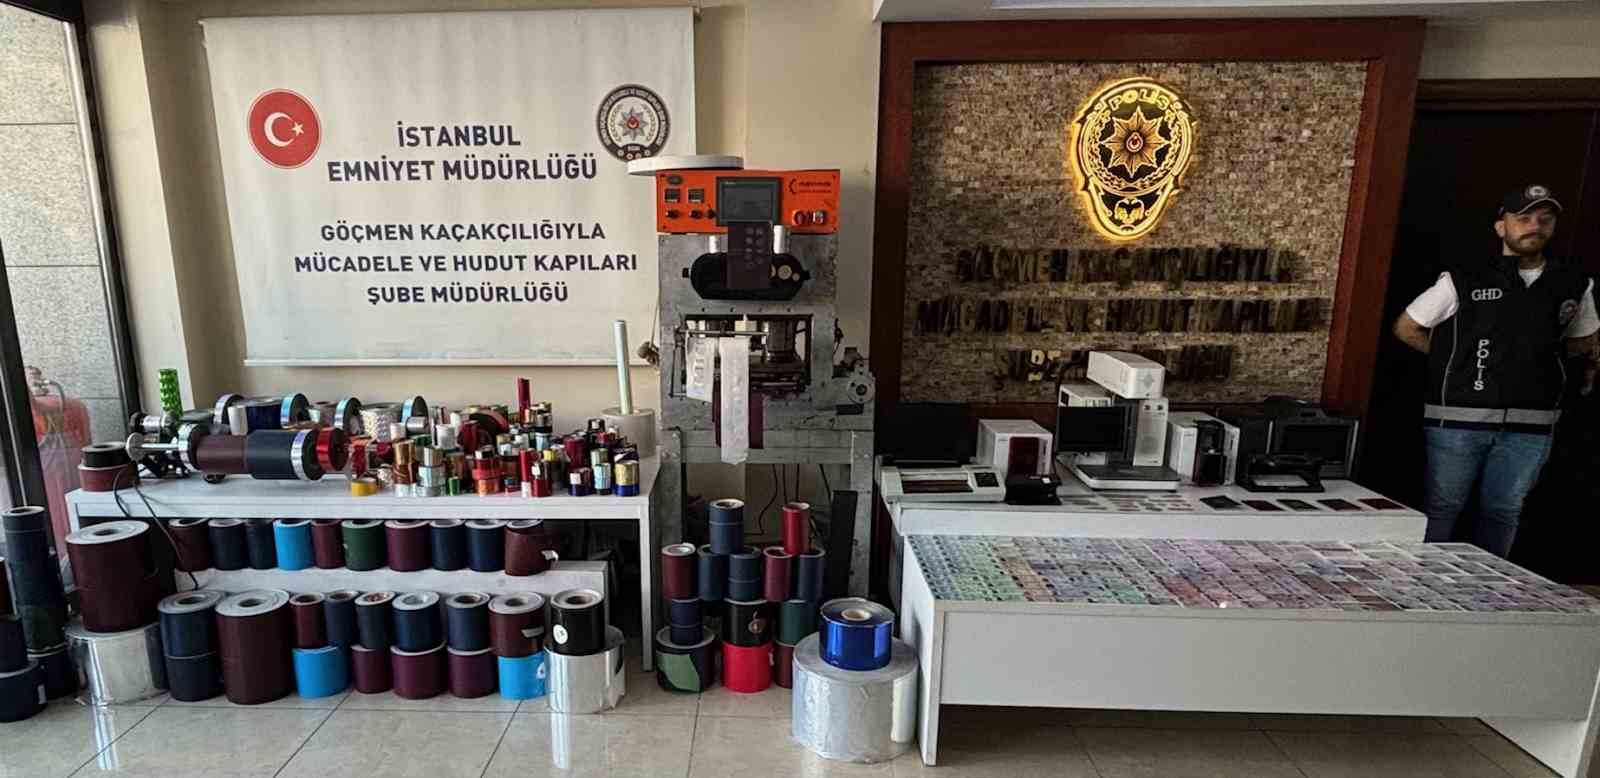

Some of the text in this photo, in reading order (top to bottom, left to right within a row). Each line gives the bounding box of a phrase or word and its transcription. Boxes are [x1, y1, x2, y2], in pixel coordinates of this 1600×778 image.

[397, 120, 521, 148] İSTANBUL
[327, 152, 597, 182] EMNİYET MÜDÜRLÜĞÜ
[320, 218, 606, 243] GÖÇMEN KAÇAKÇILIĞIYLA
[294, 251, 638, 273] MÜCADELE VE HUDUT KAPILARI
[366, 281, 569, 304] ŞUBE MÜDÜRLÜĞÜ
[1471, 288, 1503, 301] GHD
